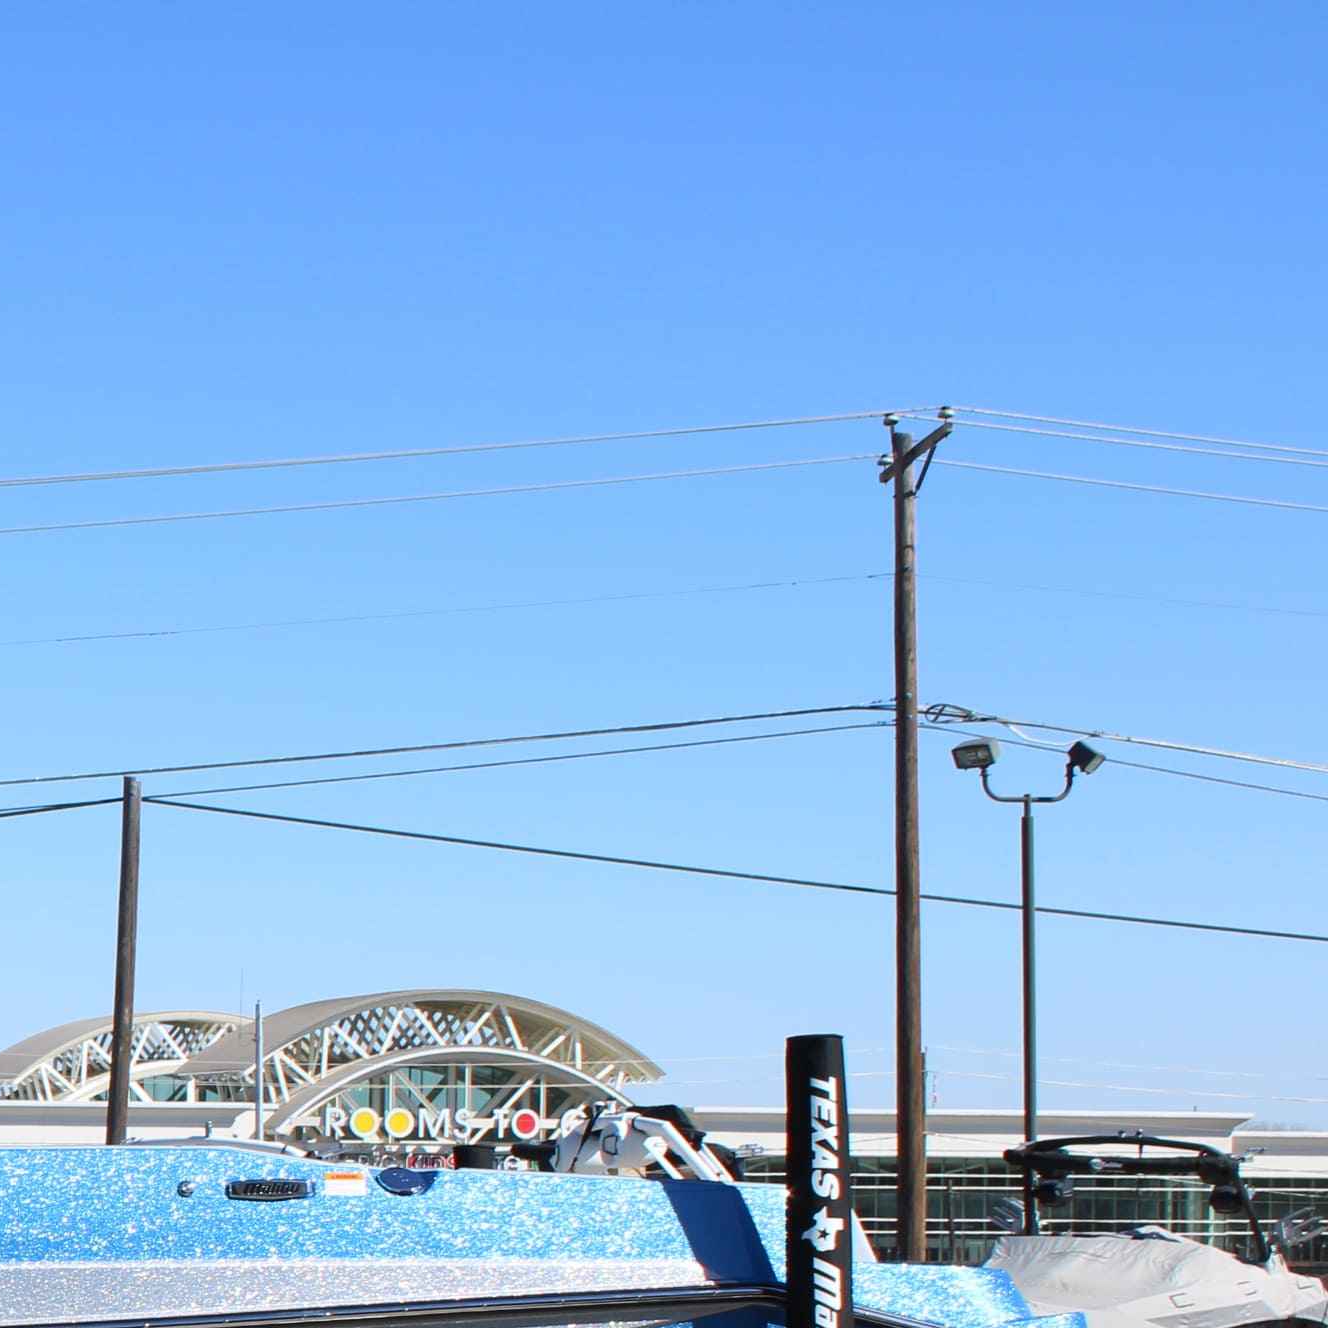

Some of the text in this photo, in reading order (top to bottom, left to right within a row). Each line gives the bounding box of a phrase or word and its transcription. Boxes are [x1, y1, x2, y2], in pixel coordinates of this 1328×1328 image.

[325, 1107, 471, 1139] ROOMS
[494, 1108, 540, 1139] TO
[810, 1076, 840, 1201] TEXAS
